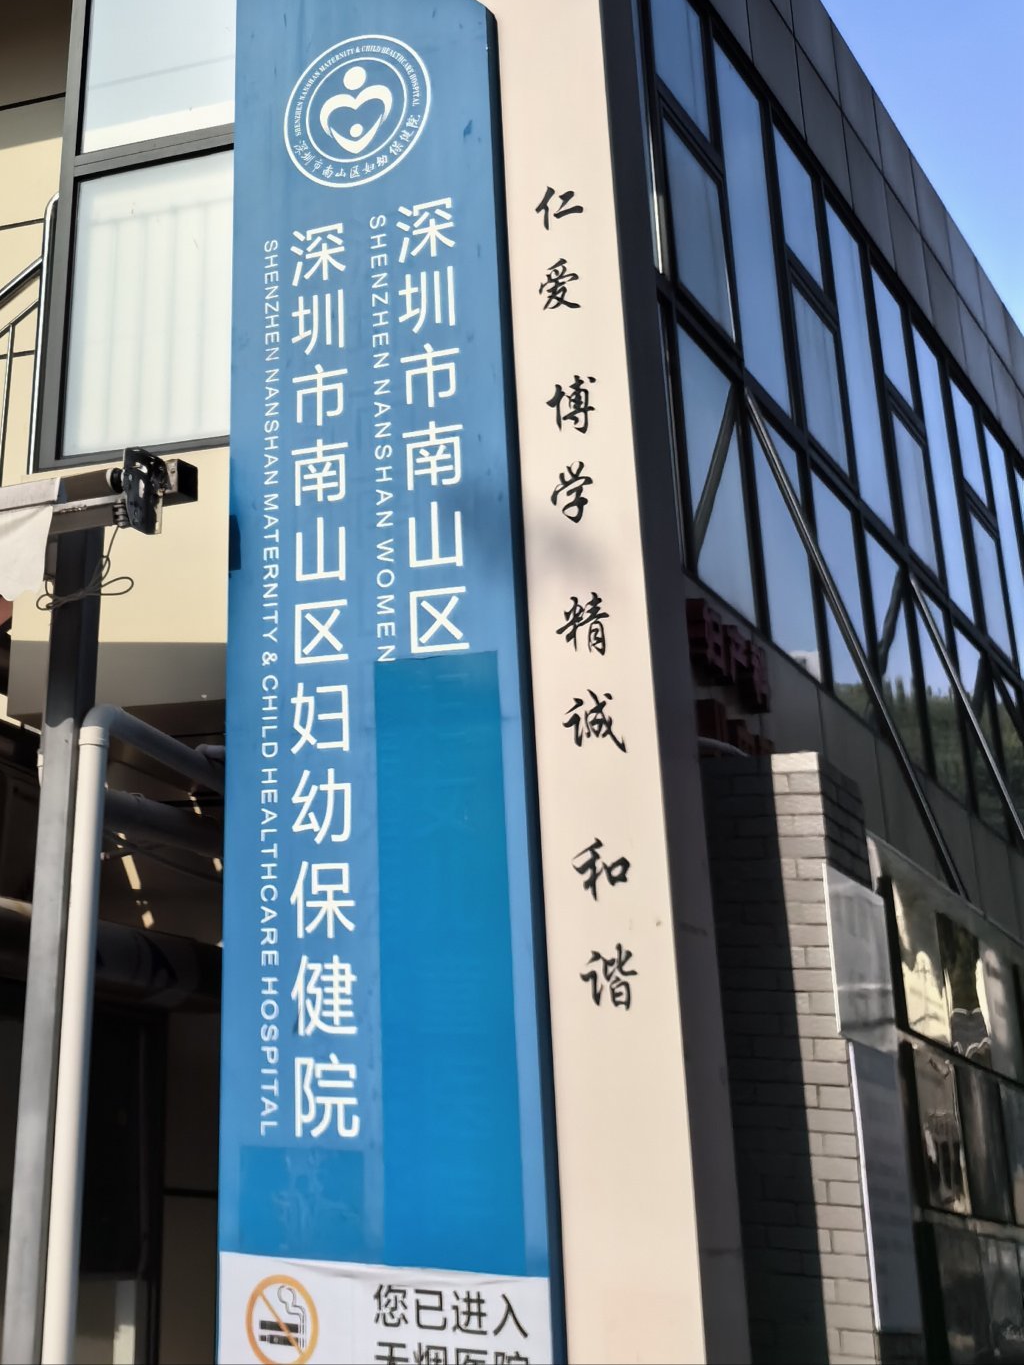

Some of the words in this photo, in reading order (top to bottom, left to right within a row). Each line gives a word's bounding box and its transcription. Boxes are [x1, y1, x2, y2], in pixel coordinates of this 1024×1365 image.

[299, 71, 321, 101] NANSHAN
[319, 47, 355, 73] MATERNITY
[361, 45, 381, 53] CHILD
[408, 73, 421, 107] HOSPITAL
[264, 239, 280, 362] SHENZHEN
[369, 214, 391, 369] SHENZHEN
[535, 186, 584, 311] 仁爱
[263, 368, 280, 485] NANSHAN
[374, 378, 394, 527] NANSHAN
[396, 197, 470, 654] 深圳市南山区
[546, 374, 597, 524] 博学
[262, 493, 280, 643] MATERNITY
[376, 538, 396, 662] WOMEN
[261, 651, 279, 667] &
[261, 674, 279, 758] CHILD
[290, 223, 360, 1138] 深圳市南山区妇幼保健院
[555, 591, 628, 753] 精诚
[260, 767, 279, 967] HEALTHCARE
[572, 837, 638, 1011] 和谐
[260, 976, 280, 1137] HOSPITAL
[374, 1284, 528, 1338] 您已进入
